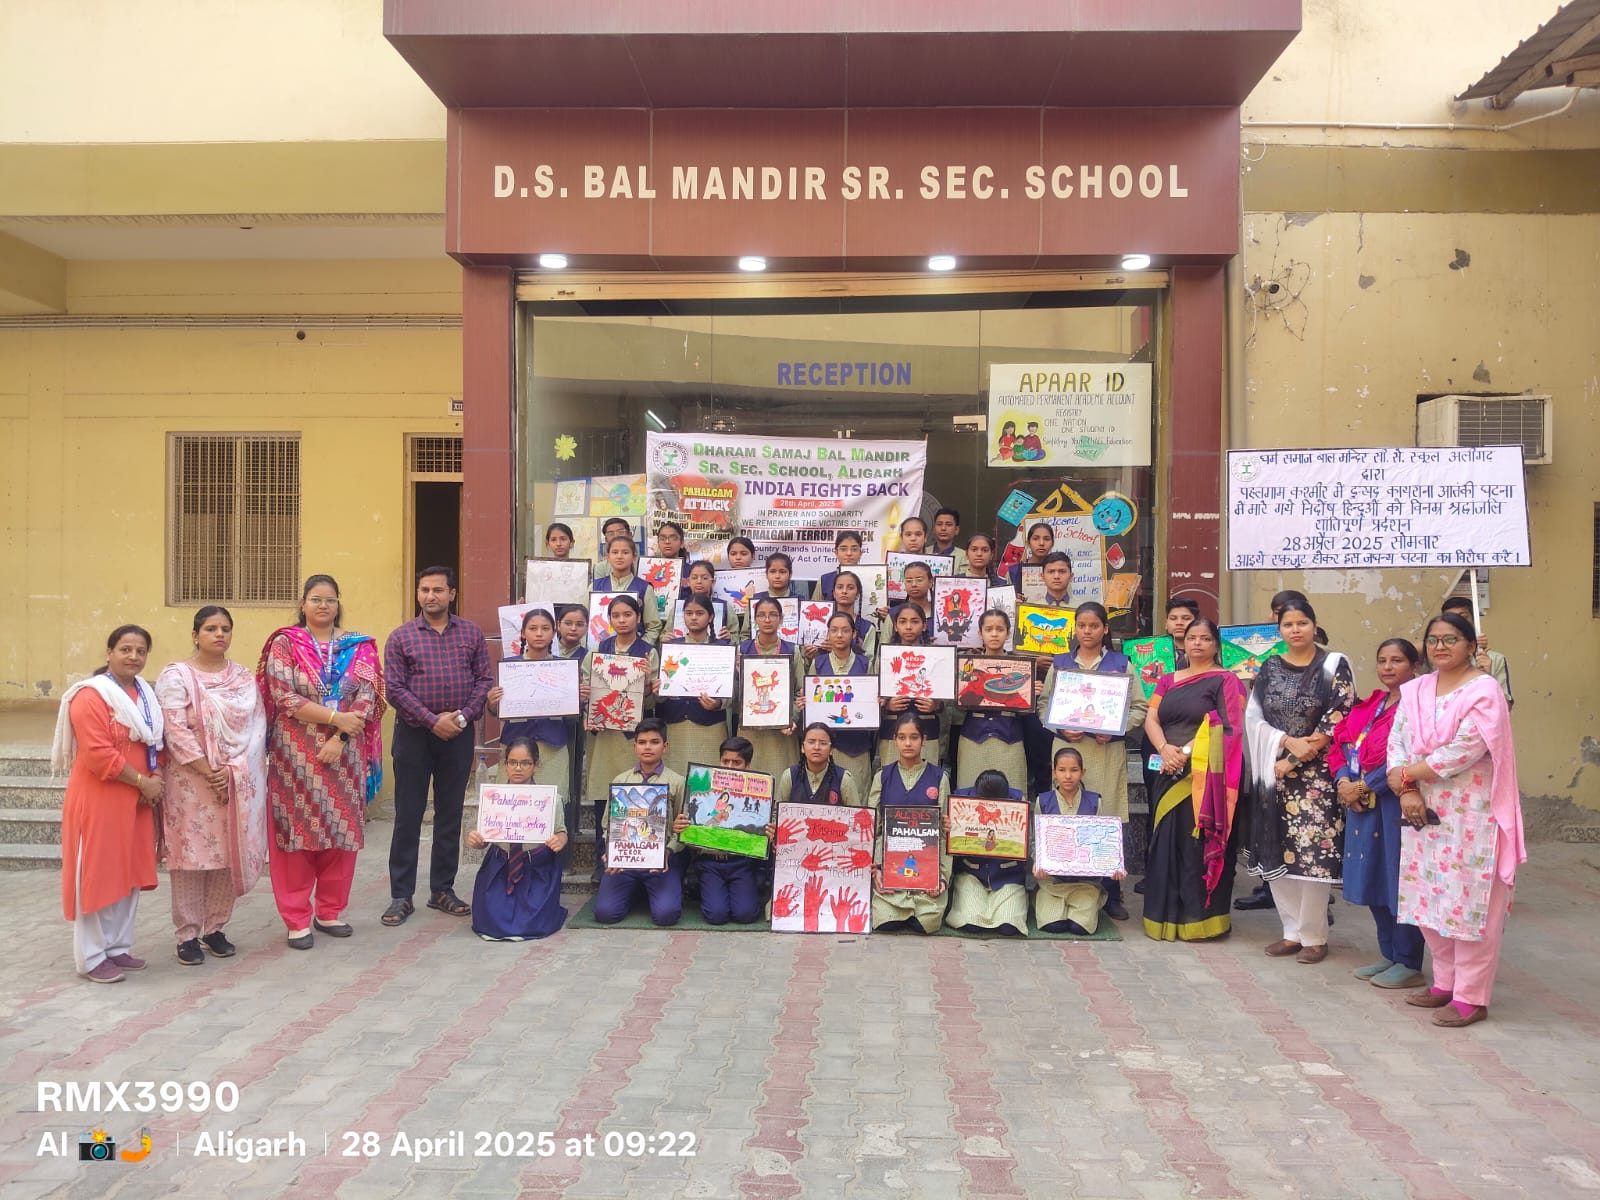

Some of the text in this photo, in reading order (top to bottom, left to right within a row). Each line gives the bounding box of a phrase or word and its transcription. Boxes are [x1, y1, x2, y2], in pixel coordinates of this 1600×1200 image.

[495, 165, 1188, 200] D.S. BAL MANDIR SR. SEC. SCHOOL
[777, 362, 911, 386] RECEPTION
[1020, 372, 1124, 392] APAAR ID
[1107, 393, 1135, 405] ACCOUNT
[694, 443, 910, 462] DHARAM SAMAJ BAL MANDIR
[1410, 450, 1440, 463] स्कूल
[698, 460, 903, 480] SR. SEC. SCHOOL, ALIGARH
[1361, 468, 1384, 481] द्वारा
[683, 486, 733, 498] PAHALGAM
[744, 480, 909, 498] INDIA FIGHTS BACK
[1240, 486, 1285, 500] पहलगाम
[1290, 482, 1328, 499] कश्मीर
[1480, 485, 1513, 498] घटना
[683, 498, 730, 511] ATTACK
[798, 500, 816, 508] April,
[667, 511, 692, 520] Mourn
[819, 510, 864, 518] SOLIDARITY
[690, 522, 715, 530] United
[756, 519, 799, 527] REMEMBER
[864, 520, 878, 528] THE
[687, 531, 705, 539] ever
[706, 532, 730, 540] Forget
[741, 529, 793, 541] PAHALGAM
[796, 530, 834, 541] TERROR
[1064, 525, 1100, 545] School
[754, 545, 780, 554] ountry
[782, 545, 809, 553] Stands
[1282, 536, 1301, 551] 28
[1342, 536, 1383, 551] 2025
[892, 827, 939, 837] PAHALGAM
[614, 841, 660, 850] PAHALGAM
